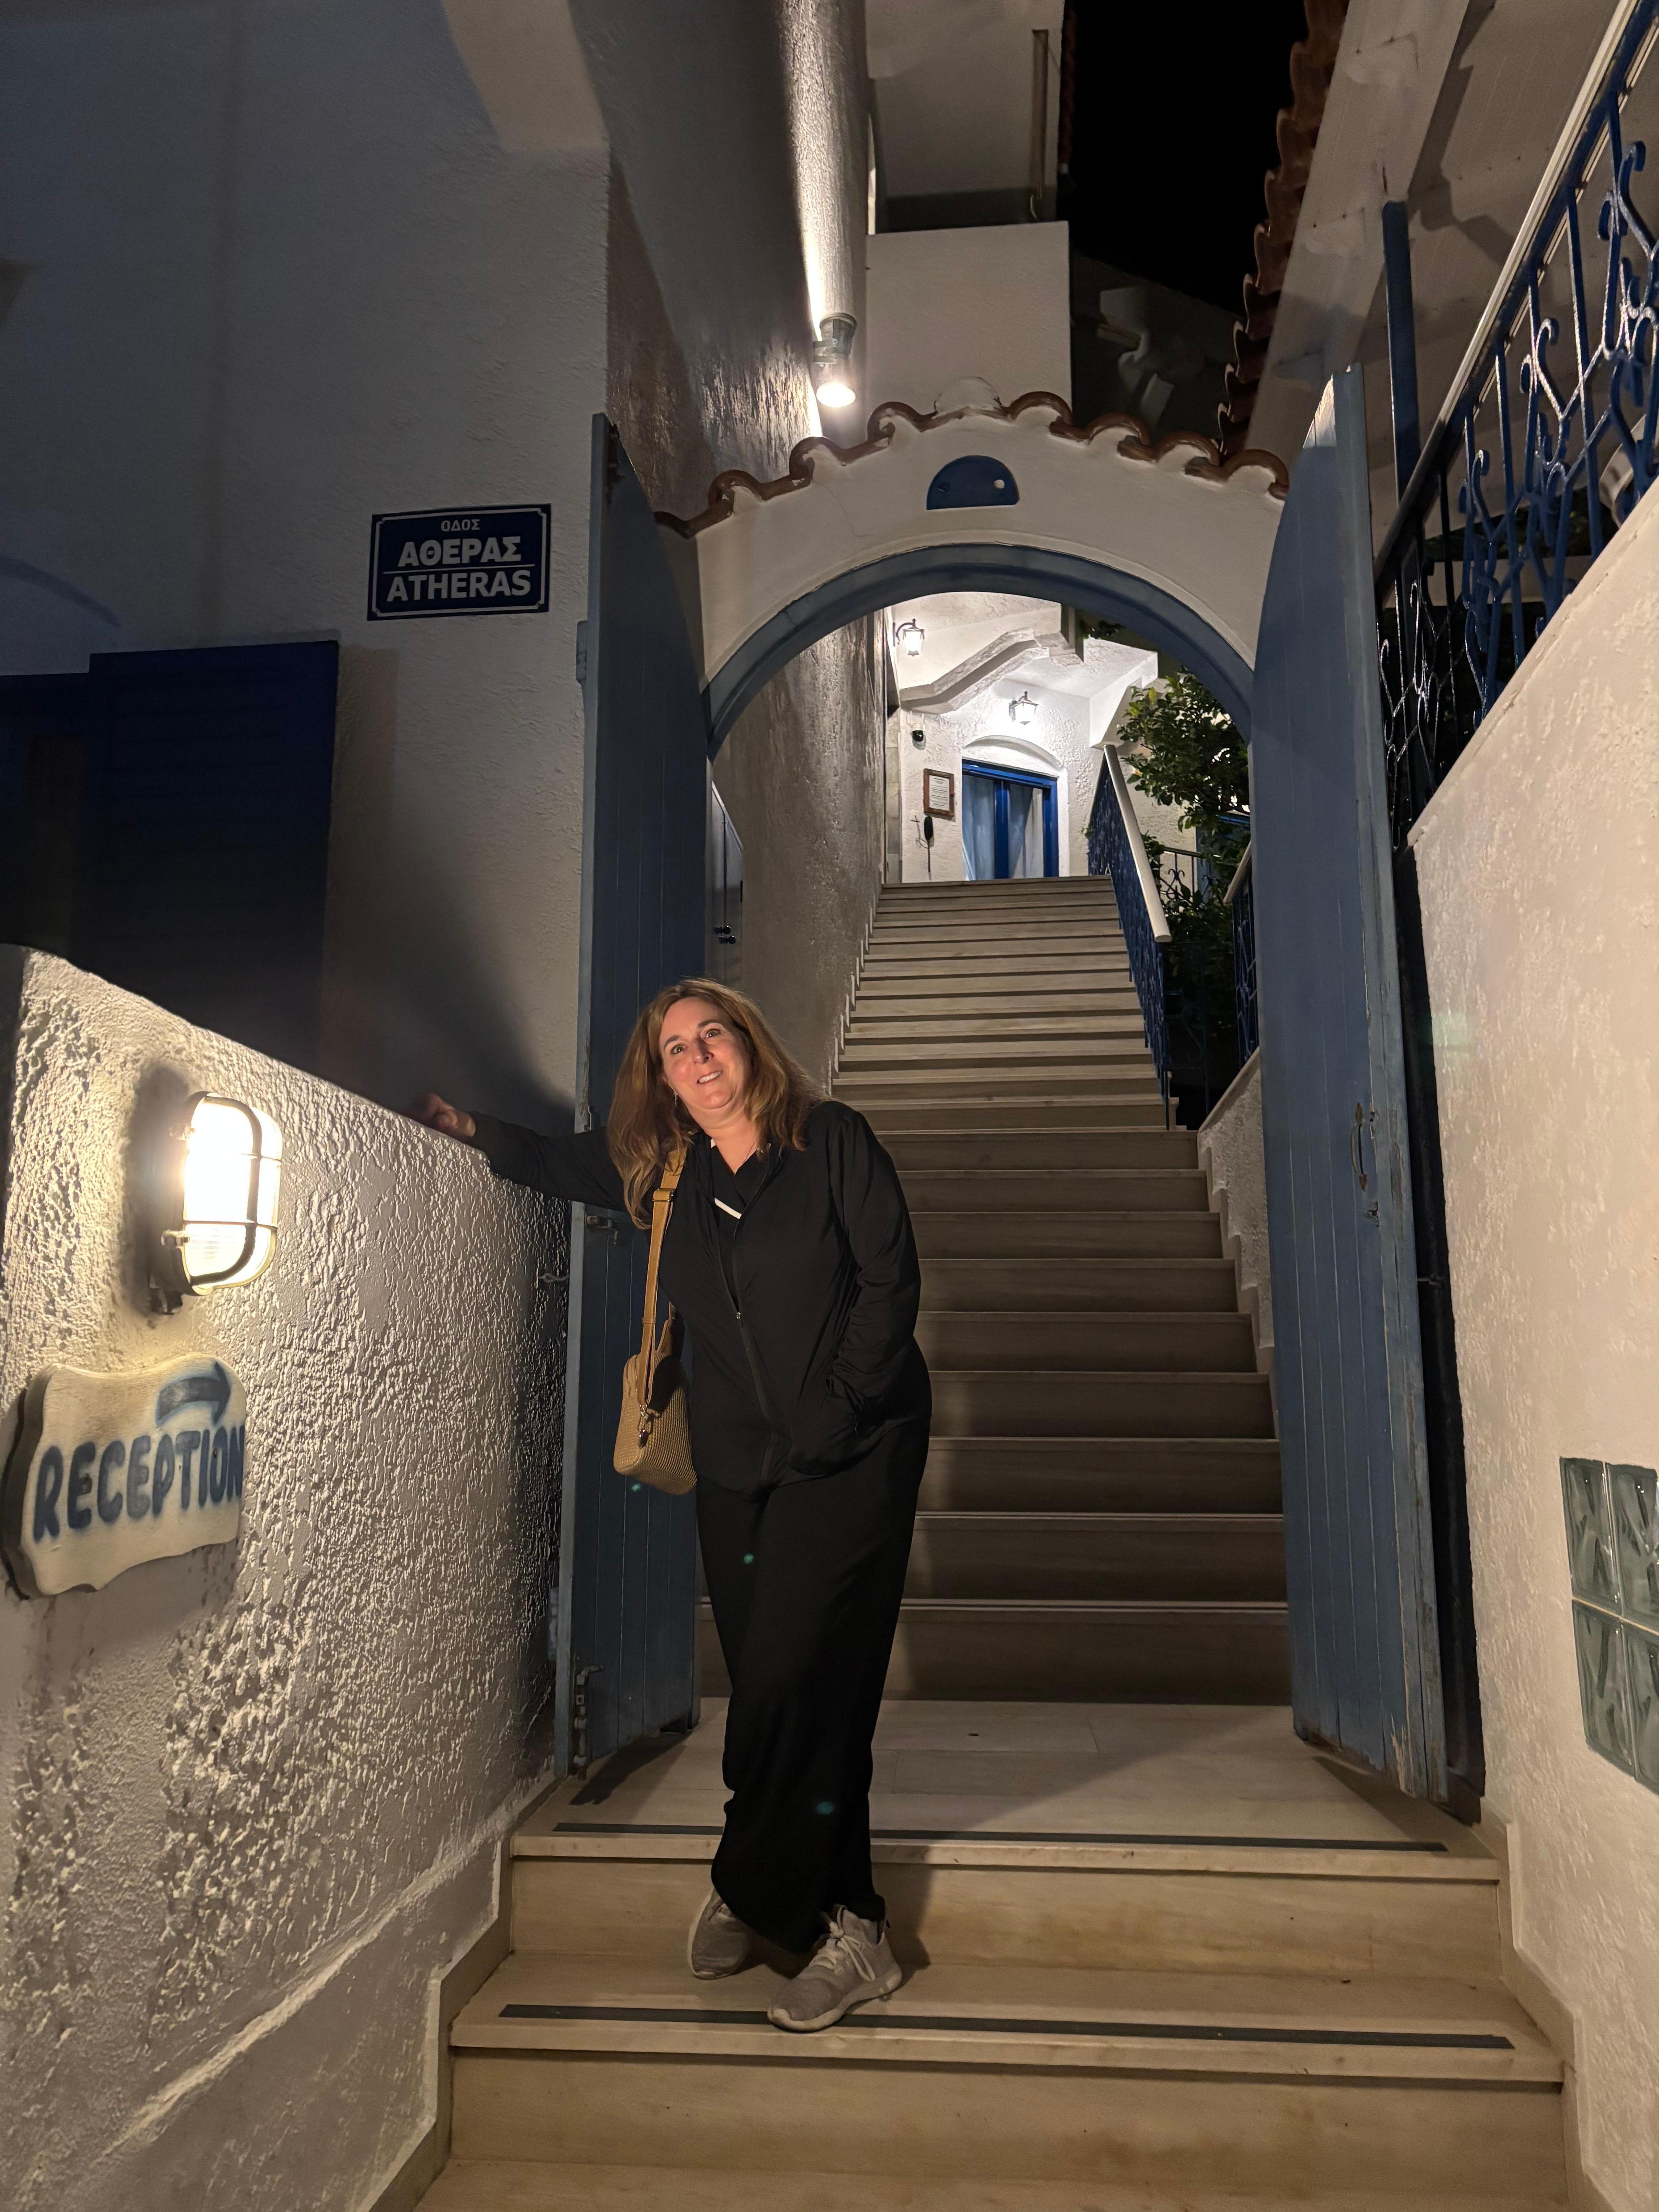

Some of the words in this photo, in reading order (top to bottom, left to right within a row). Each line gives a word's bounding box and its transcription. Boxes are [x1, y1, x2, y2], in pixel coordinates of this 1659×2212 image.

[441, 519, 480, 532] ΟΔΟΣ
[398, 536, 521, 567] ΑΘΕΡΑΣ
[387, 570, 531, 602] ATHERAS
[33, 1425, 245, 1543] RECEPTION
